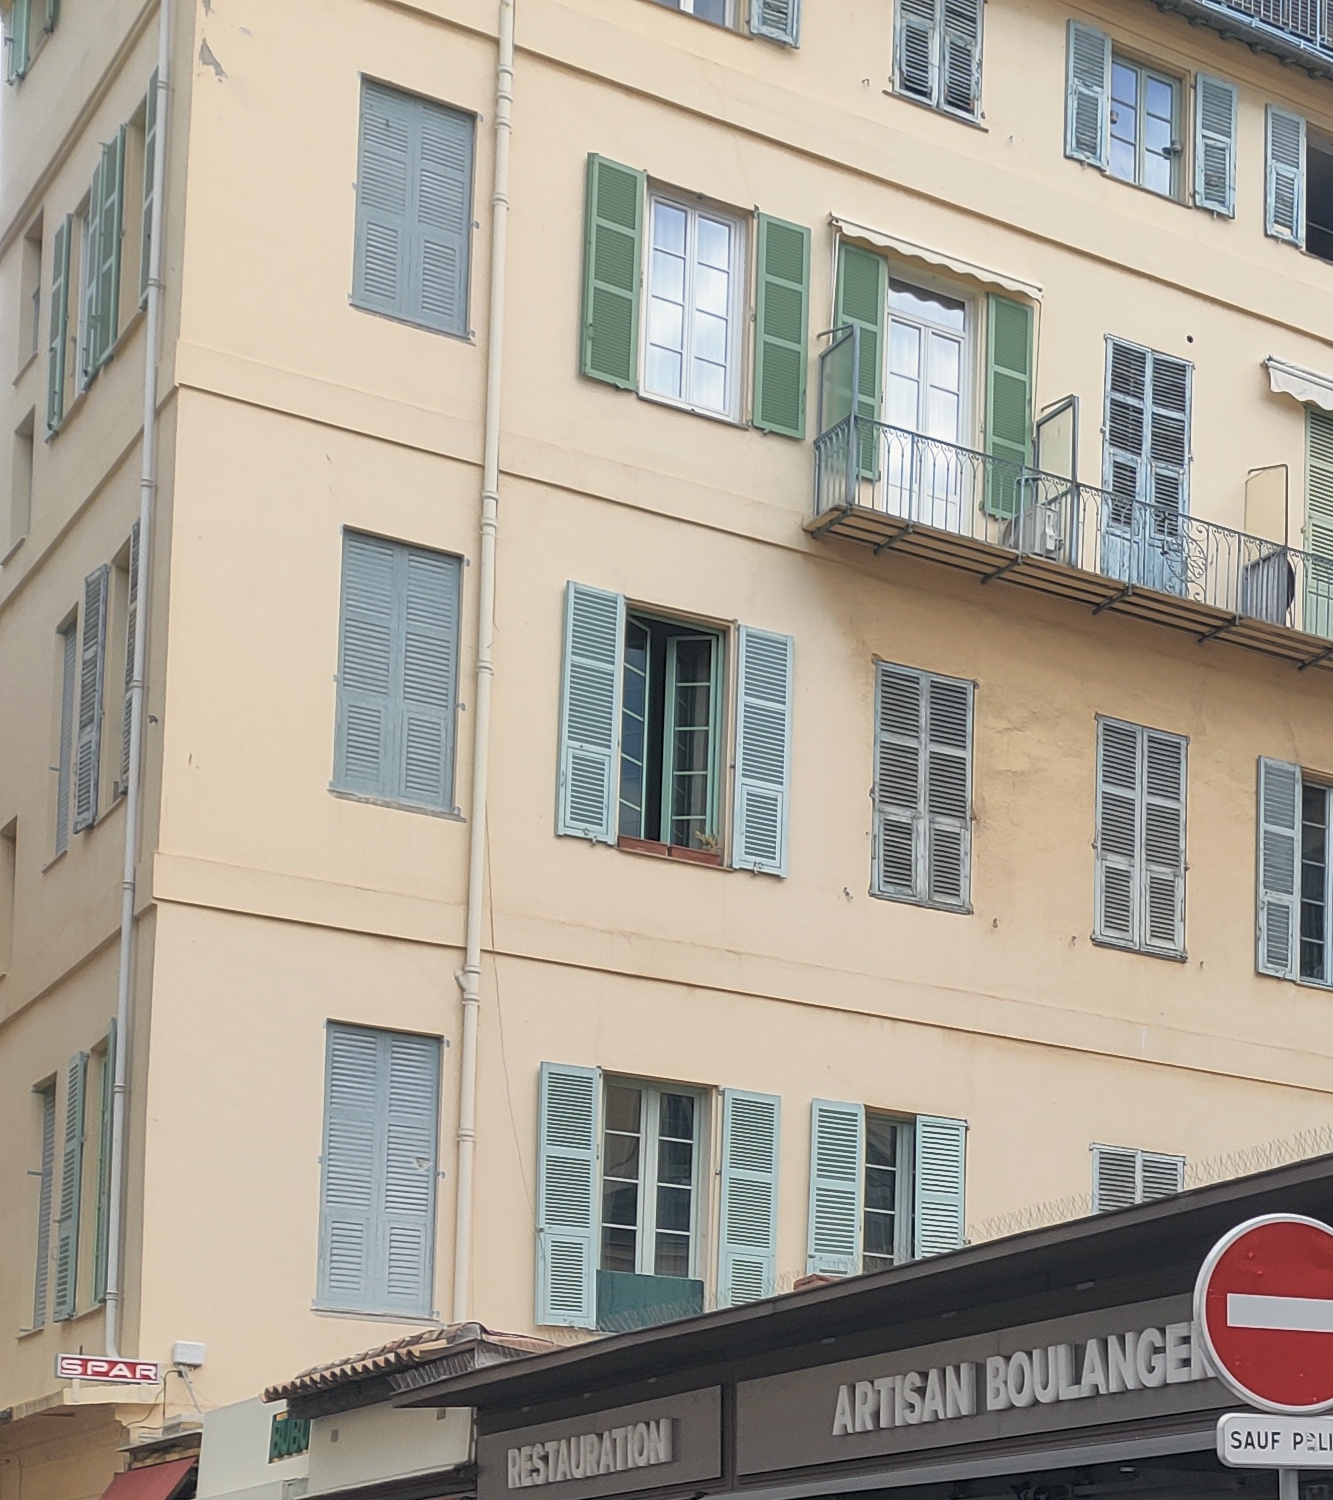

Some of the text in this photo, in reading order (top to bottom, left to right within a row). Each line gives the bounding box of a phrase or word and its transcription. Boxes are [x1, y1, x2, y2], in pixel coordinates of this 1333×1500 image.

[60, 1359, 158, 1380] SPAR
[832, 1362, 976, 1436] ARTISAN
[508, 1418, 672, 1488] RESTAURATION
[1230, 1431, 1281, 1450] SAUF
